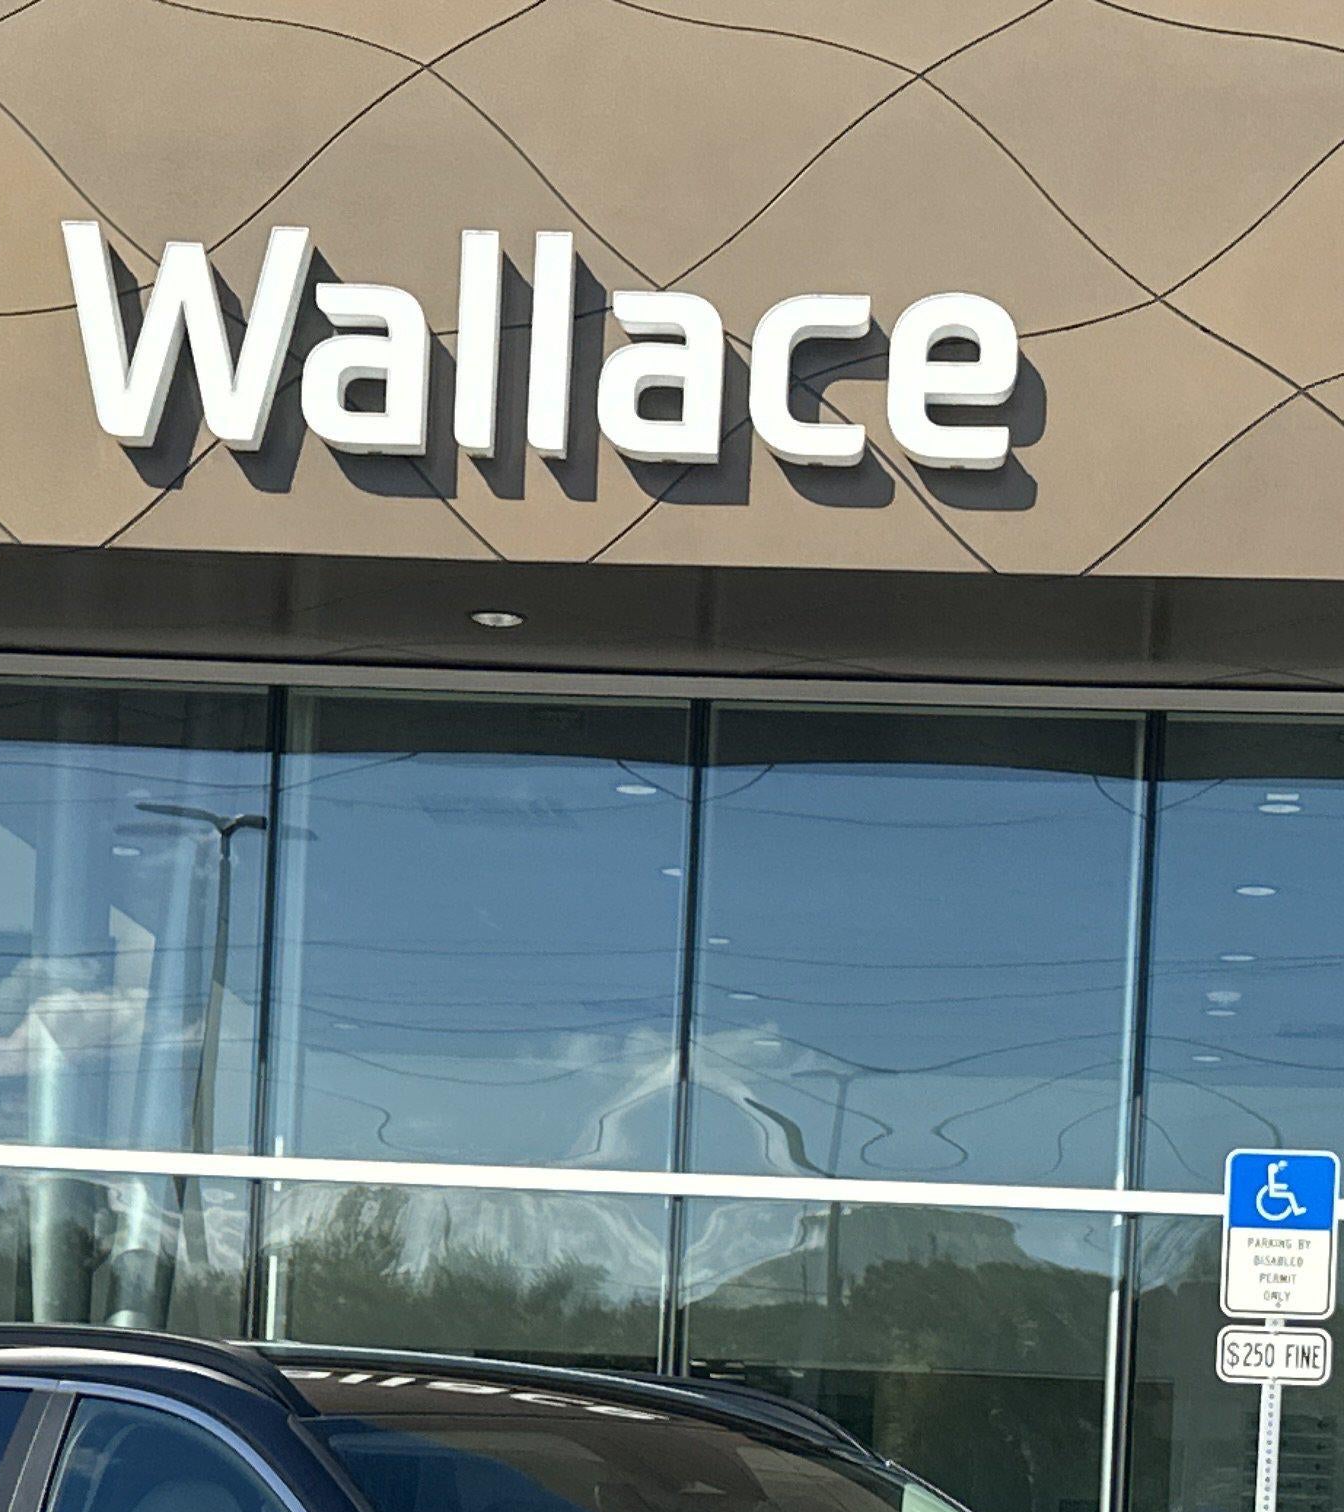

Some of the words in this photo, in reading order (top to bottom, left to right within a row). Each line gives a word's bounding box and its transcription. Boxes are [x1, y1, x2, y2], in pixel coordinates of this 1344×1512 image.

[61, 220, 1020, 470] Wallace
[1247, 1237, 1292, 1249] PARKING
[1298, 1239, 1312, 1250] BY
[1227, 1342, 1275, 1369] $250
[1285, 1343, 1322, 1370] FINE
